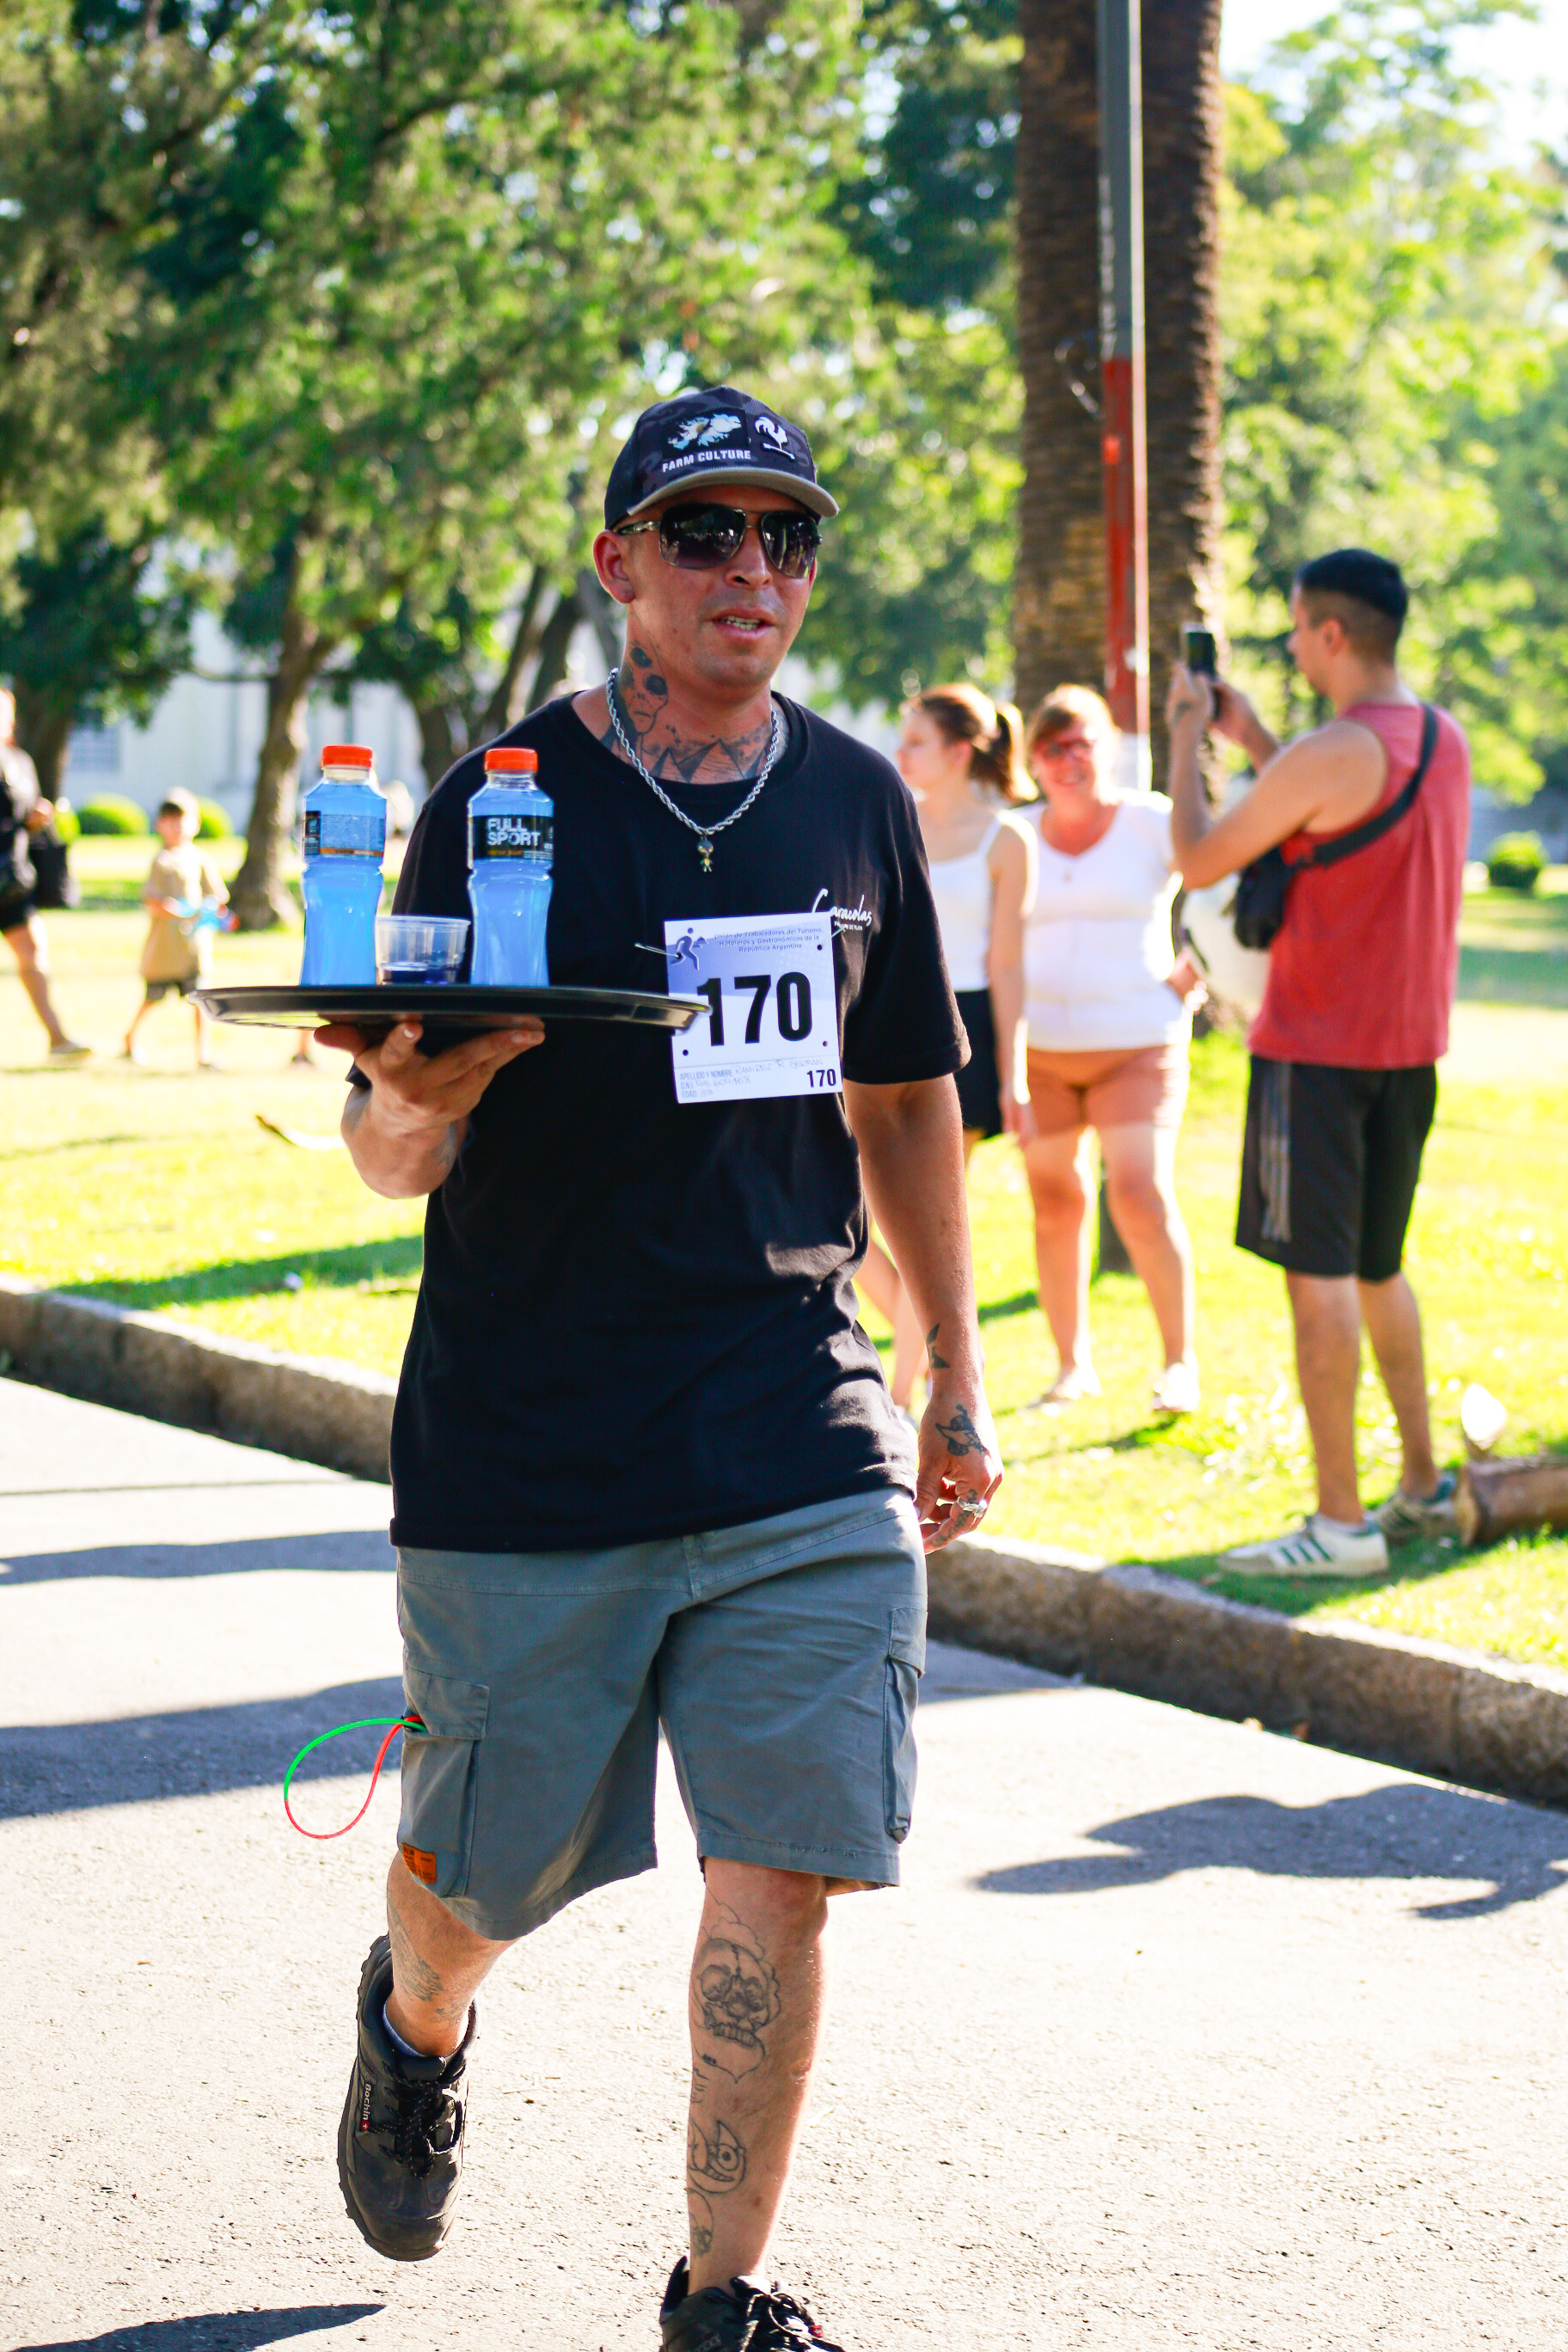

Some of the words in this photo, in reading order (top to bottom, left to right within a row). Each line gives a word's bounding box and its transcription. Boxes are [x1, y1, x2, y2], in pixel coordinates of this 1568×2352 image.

[662, 454, 695, 473] FARM
[697, 449, 751, 462] CULTURE
[487, 818, 528, 832] FULL
[487, 830, 541, 847] SPORT
[696, 971, 813, 1046] 170
[680, 1071, 705, 1081] APELLIDO
[806, 1069, 836, 1088] 170
